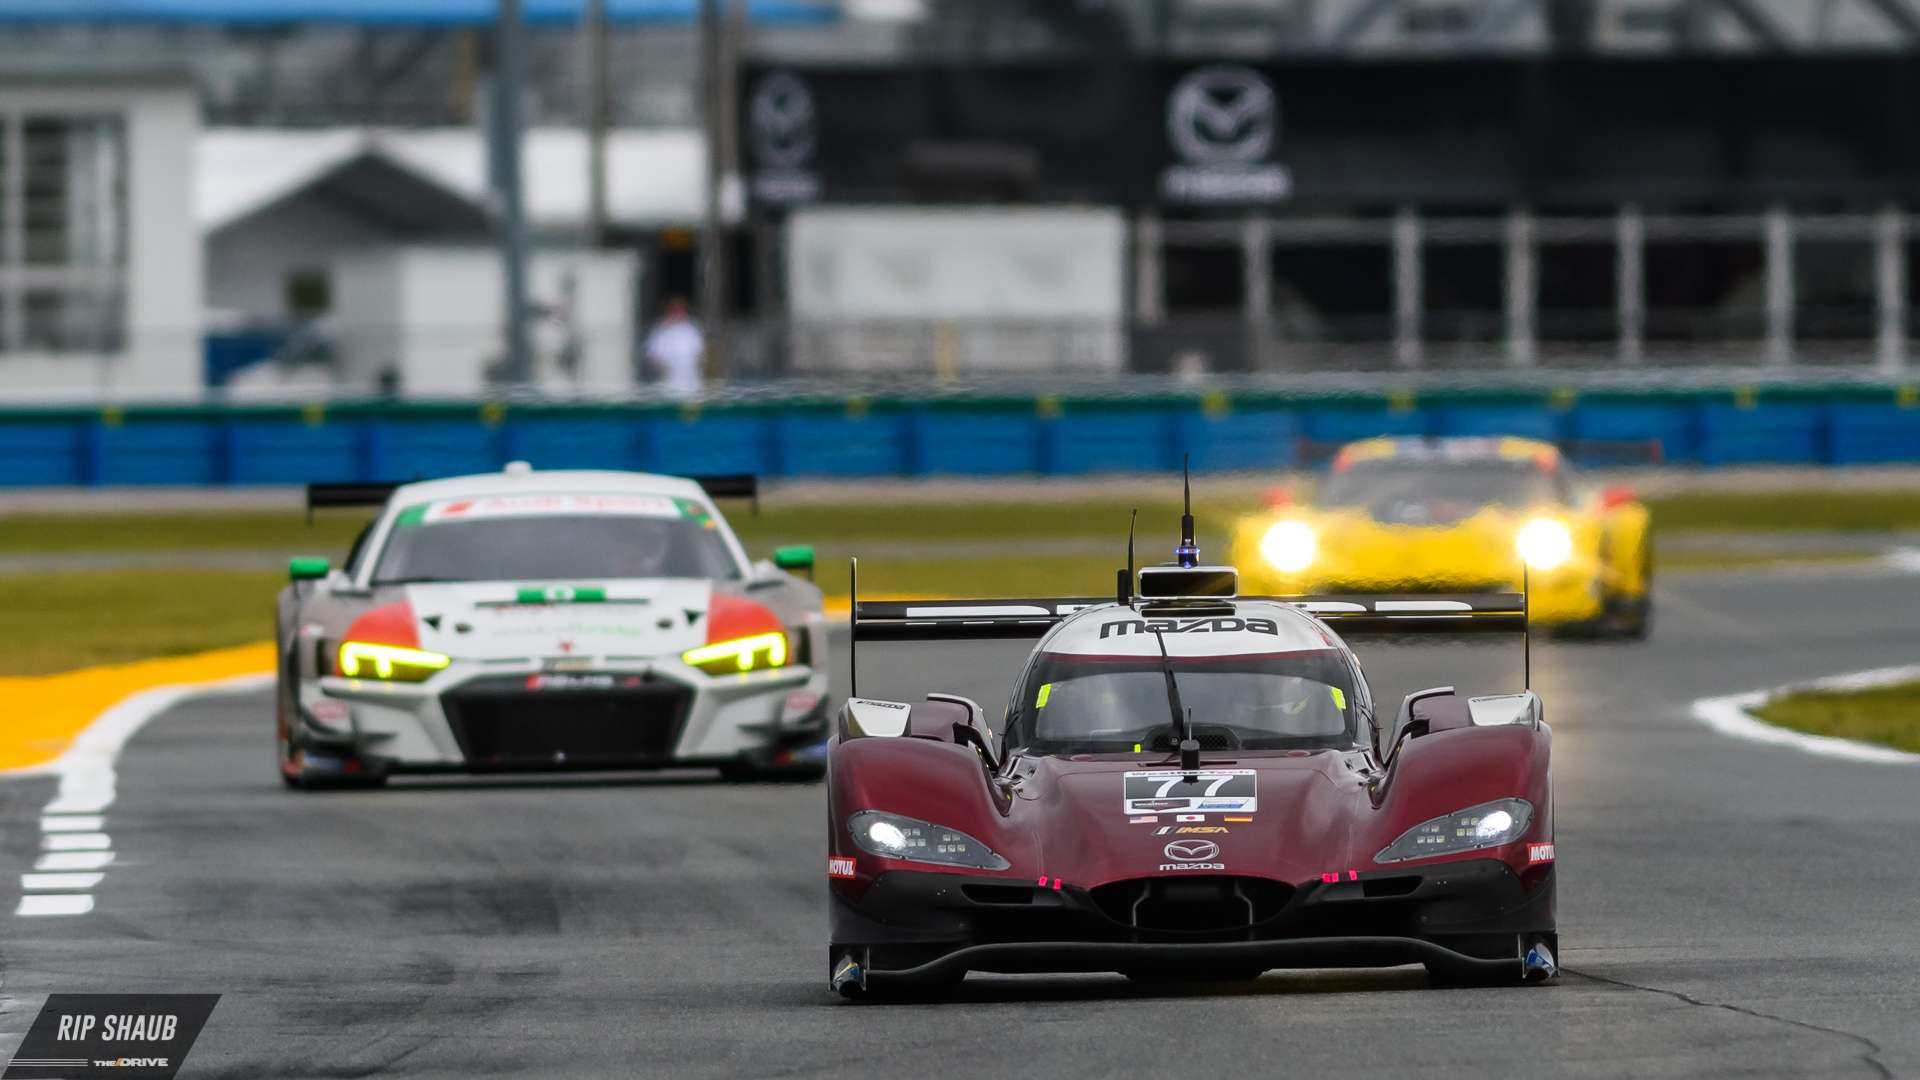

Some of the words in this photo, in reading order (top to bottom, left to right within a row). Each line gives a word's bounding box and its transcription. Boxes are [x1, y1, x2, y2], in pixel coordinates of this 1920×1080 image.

[1099, 617, 1279, 640] mazda
[1147, 775, 1234, 798] 77
[1175, 826, 1230, 834] IMSA
[1159, 862, 1225, 871] mazda
